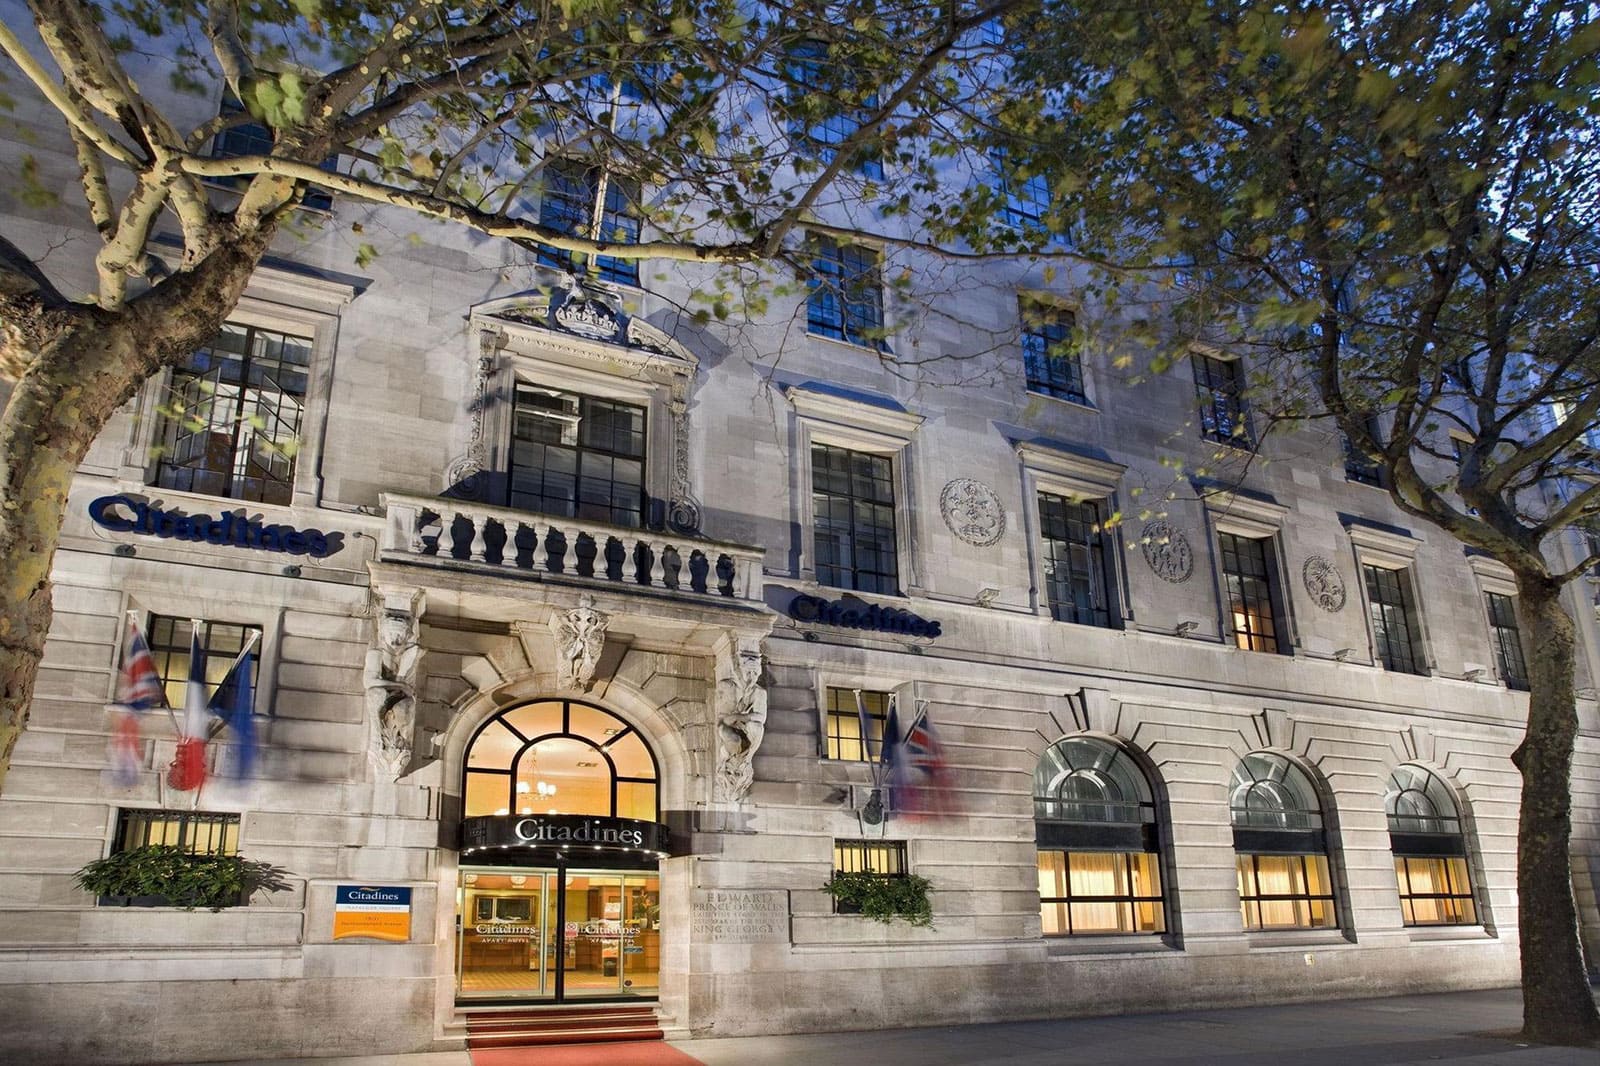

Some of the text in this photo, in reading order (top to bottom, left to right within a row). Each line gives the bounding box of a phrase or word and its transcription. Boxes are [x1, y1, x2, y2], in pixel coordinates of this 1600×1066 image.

[88, 495, 330, 557] Citadines
[788, 594, 942, 638] Citadines
[514, 818, 643, 846] Citadines
[348, 891, 399, 901] Citadines
[707, 893, 773, 903] EDWARD
[693, 903, 785, 911] PRINCE OF WALES
[476, 923, 536, 934] Citadines
[585, 923, 641, 934] Citadines
[693, 925, 722, 933] KING
